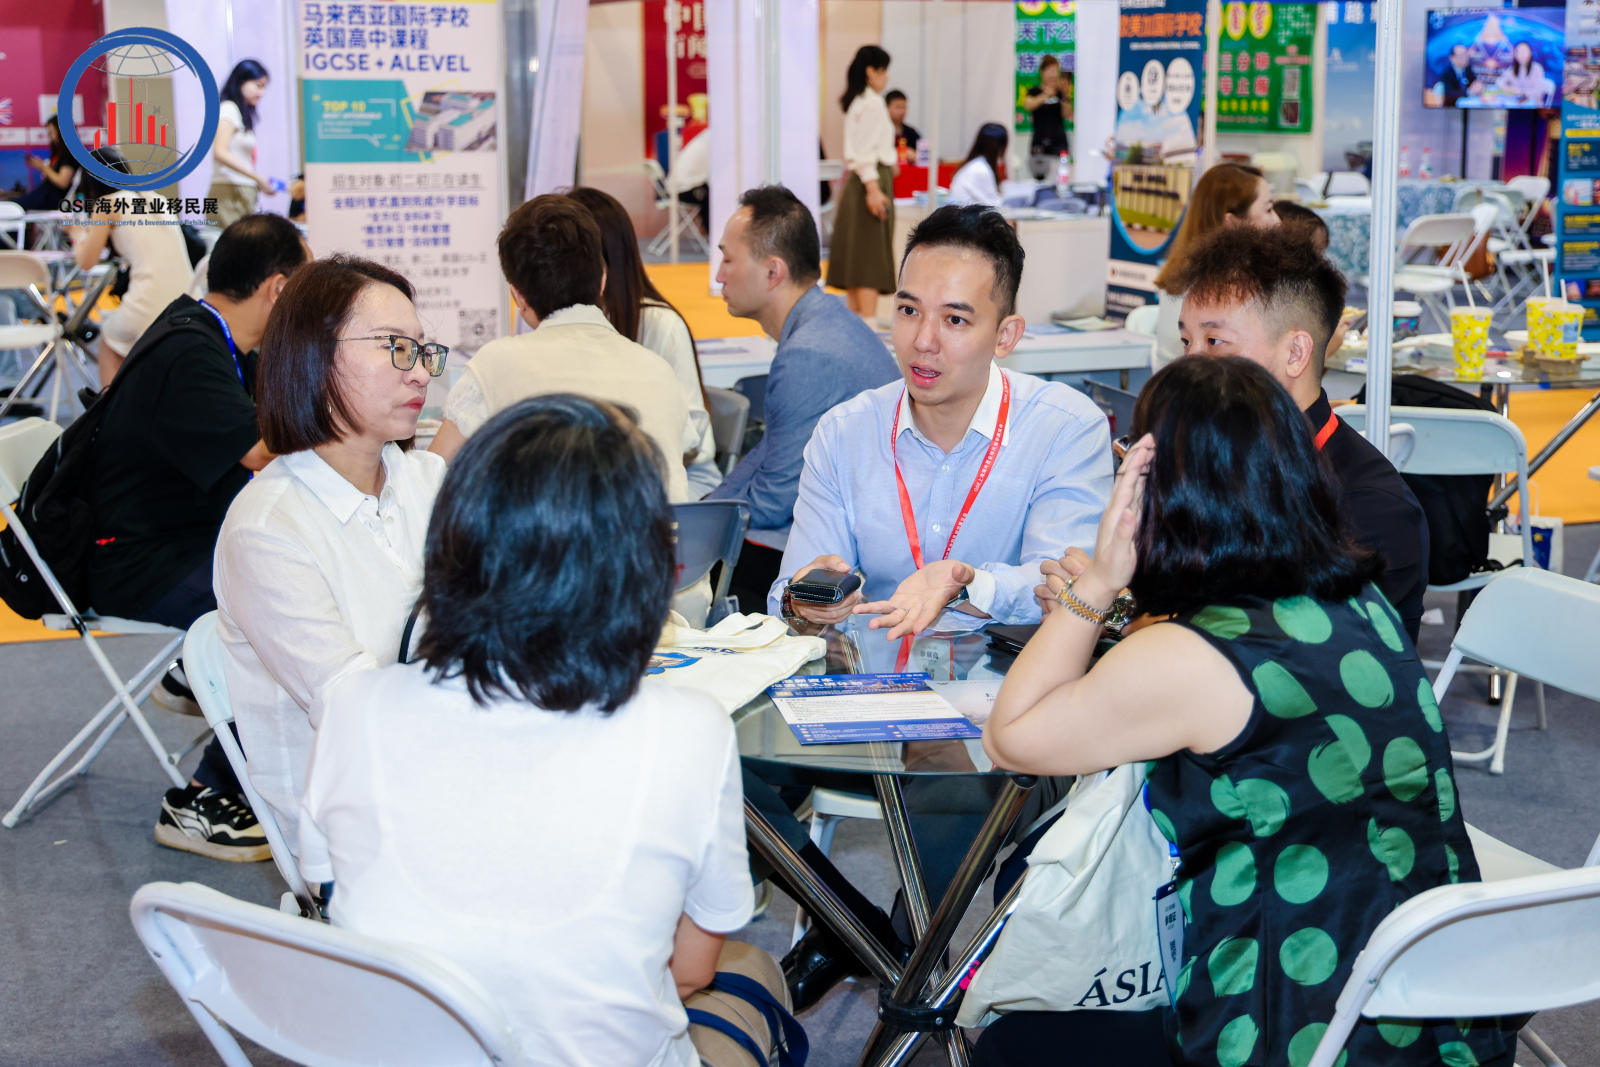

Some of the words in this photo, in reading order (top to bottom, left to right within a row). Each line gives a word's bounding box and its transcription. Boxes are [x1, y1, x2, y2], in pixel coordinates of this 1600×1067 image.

[304, 4, 469, 27] 马来西亚国际学校
[304, 27, 429, 50] 英国高中课程
[305, 53, 370, 71] IGCSE
[390, 54, 471, 72] ALEVEL
[322, 100, 348, 112] TOP
[351, 100, 366, 112] 10
